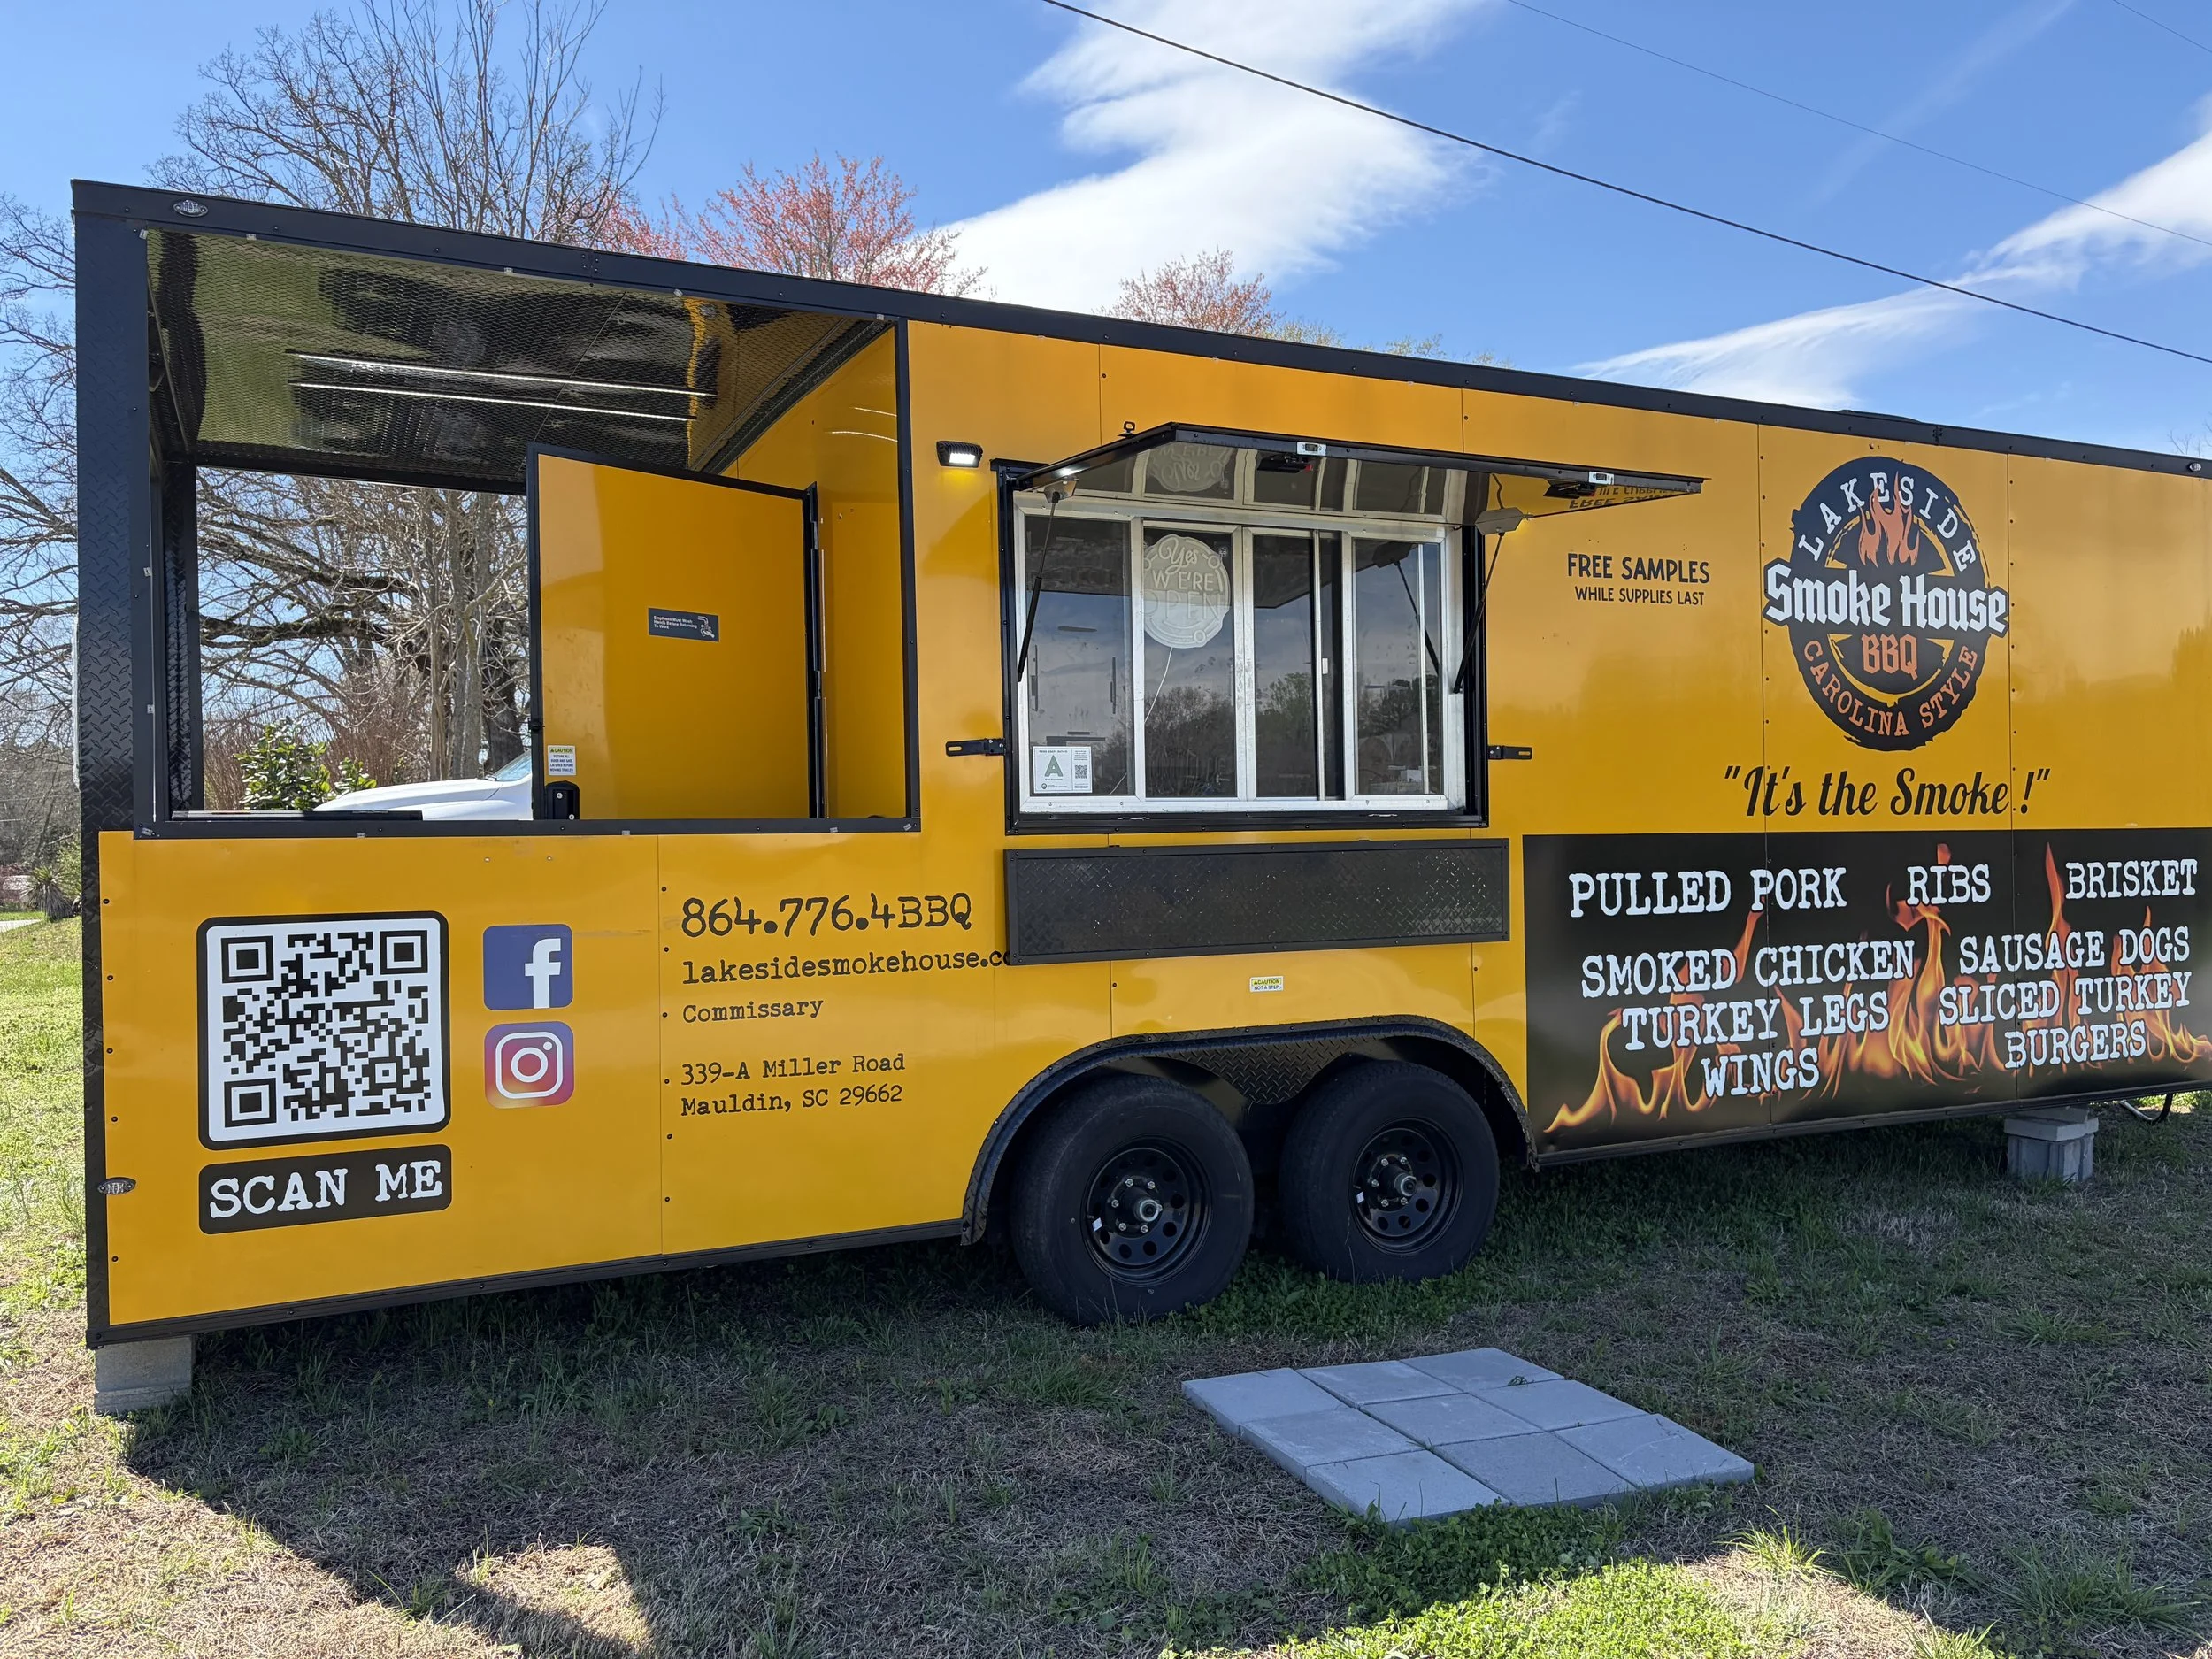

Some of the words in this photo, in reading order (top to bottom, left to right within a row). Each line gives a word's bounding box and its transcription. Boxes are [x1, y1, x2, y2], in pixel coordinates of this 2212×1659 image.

[1798, 472, 1978, 572] LAKESIDE
[1158, 536, 1199, 575] Yes
[1567, 553, 1614, 579] FREE
[1621, 557, 1710, 584] SAMPLES
[1152, 570, 1215, 592] WE'RE
[1574, 586, 1615, 602] WHILE
[1618, 588, 1672, 604] SUPPLIES
[1677, 590, 1705, 605] LAST
[1765, 563, 1892, 626] Smoke
[1899, 574, 2009, 634] House
[1862, 634, 1918, 680] BBQ
[1803, 640, 1909, 736] CAROLINA
[1918, 646, 1978, 728] STYLE
[1044, 755, 1064, 777] A
[1724, 764, 1806, 816] "It's
[1818, 770, 1878, 815] the
[1889, 768, 2009, 816] Smoke
[1569, 871, 1731, 918] PULLED
[1750, 866, 1847, 910] PORK
[1906, 864, 1992, 906] RIBS
[2065, 858, 2197, 899] BRISKET
[681, 892, 972, 937] 864.776.4BBQ
[1581, 948, 1737, 998] SMOKED
[1755, 940, 1915, 987] CHICKEN
[1959, 930, 2105, 974] SAUSAGE
[2119, 926, 2191, 964] DOGS
[683, 998, 824, 1023] Commissary
[1623, 1001, 1780, 1051] TURKEY
[1800, 991, 1889, 1036] LEGS
[1939, 979, 2059, 1025] SLICED
[2074, 972, 2192, 1015] TURKEY
[2005, 1021, 2147, 1069] BURGERS
[681, 1062, 750, 1086] 339-A
[763, 1056, 841, 1079] Miller
[852, 1054, 905, 1073] Road
[1701, 1048, 1819, 1097] WINGS
[681, 1094, 791, 1117] Mauldin,
[803, 1089, 828, 1108] SC
[840, 1085, 902, 1104] 29662
[209, 1168, 348, 1219] SCAN
[374, 1159, 442, 1202] ME
